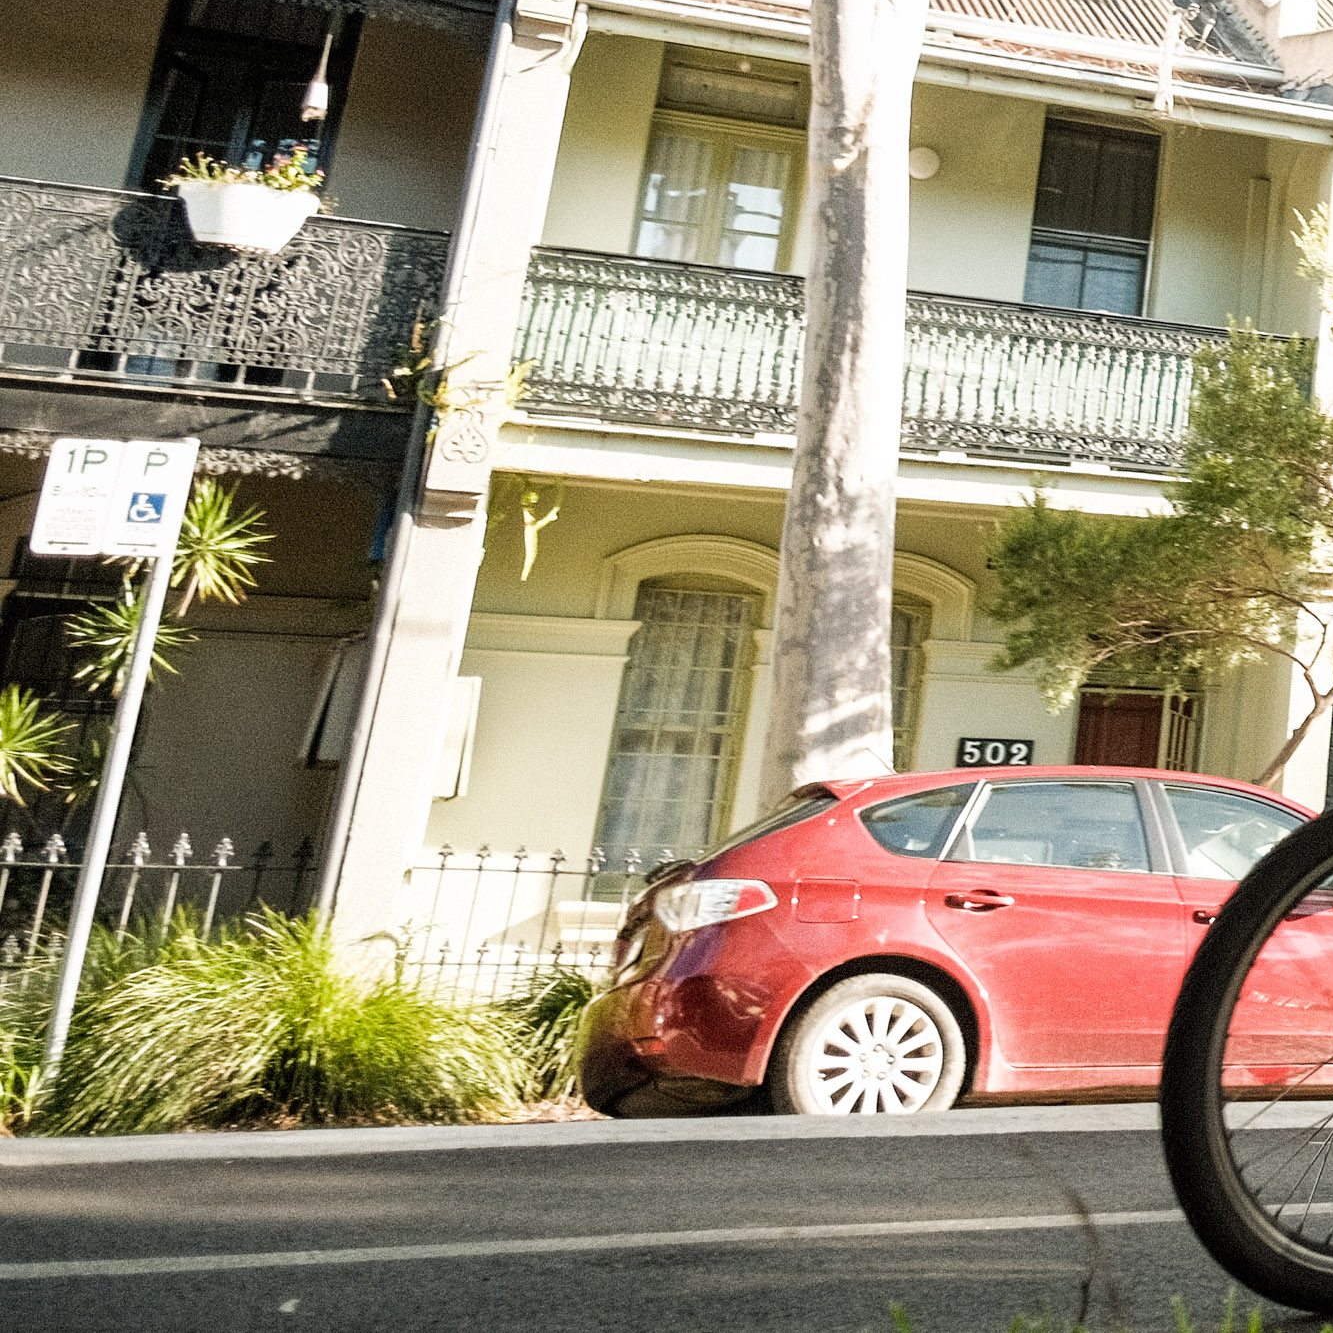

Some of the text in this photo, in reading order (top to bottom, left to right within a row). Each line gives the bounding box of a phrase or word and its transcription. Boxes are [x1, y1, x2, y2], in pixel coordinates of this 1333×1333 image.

[68, 449, 108, 474] 1P
[143, 452, 169, 476] P
[963, 741, 1028, 765] 502
